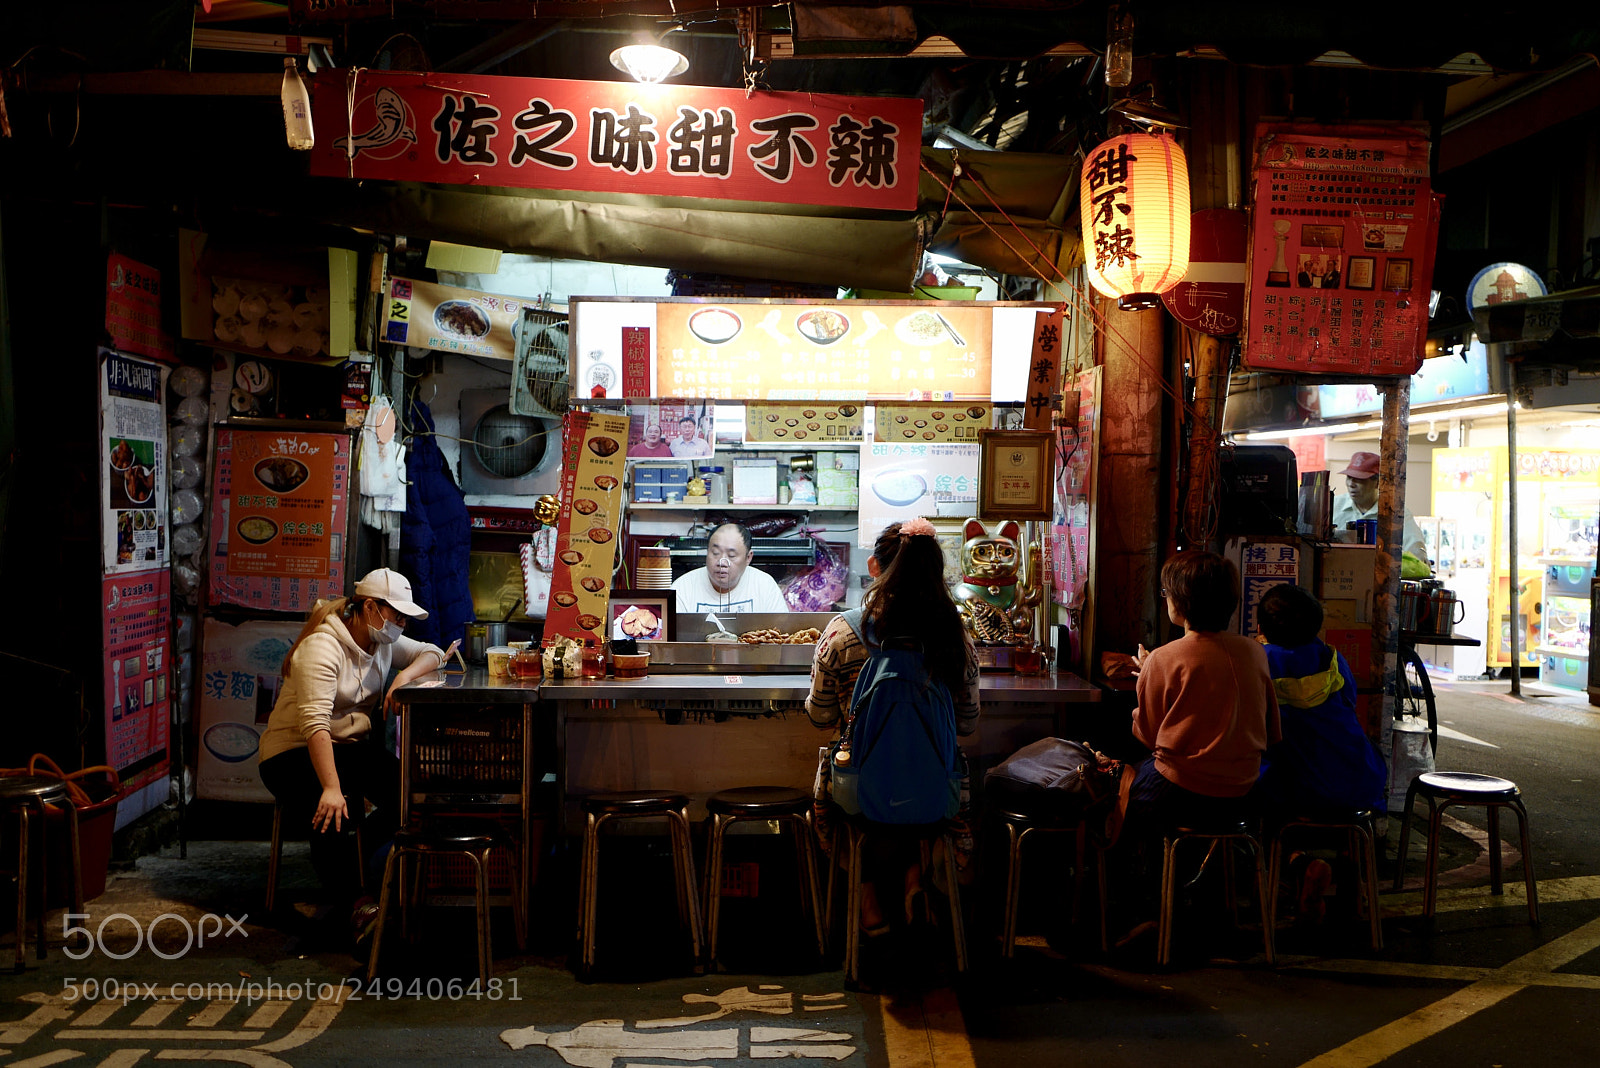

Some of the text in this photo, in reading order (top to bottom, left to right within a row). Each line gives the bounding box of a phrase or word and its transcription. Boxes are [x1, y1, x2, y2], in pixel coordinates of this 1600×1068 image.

[433, 93, 901, 190] 佐之味甜不辣
[1304, 147, 1386, 162] 佐之味甜不辣
[1086, 143, 1141, 273] 甜不辣
[1264, 295, 1277, 334] 甜不辣
[1287, 296, 1300, 335] 綜合湯
[628, 331, 645, 376] 辣椒醬
[109, 359, 152, 392] 非凡新聞
[1031, 325, 1058, 418] 營業中
[1548, 455, 1600, 471] STORY
[238, 495, 279, 510] 甜不辣
[283, 521, 324, 536] 綜合湯
[1246, 547, 1296, 562] 拷貝
[206, 671, 255, 700] 涼麵
